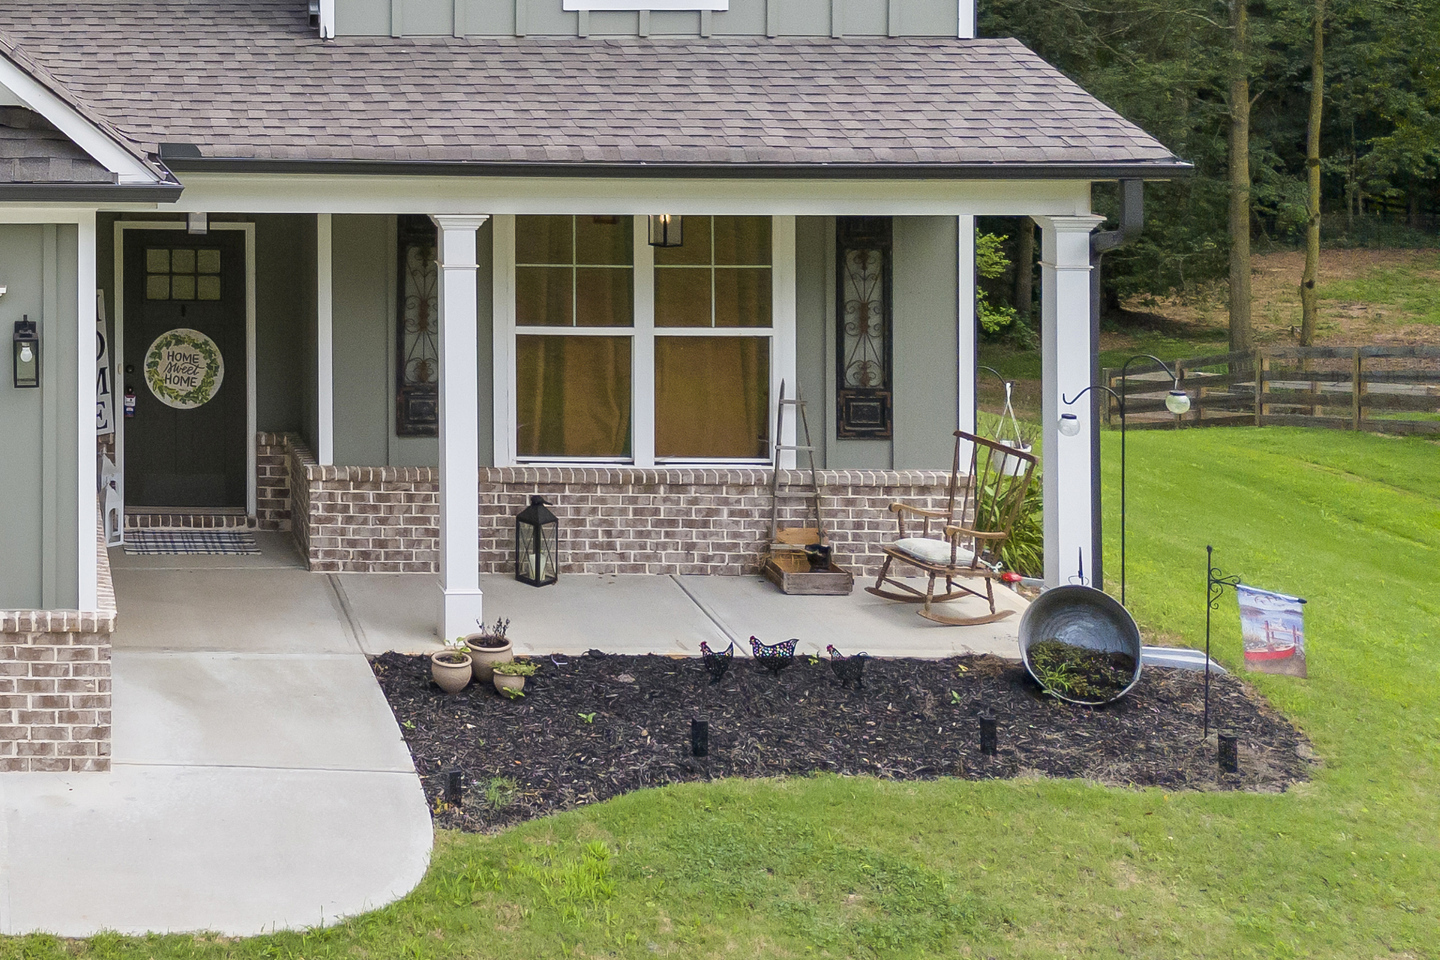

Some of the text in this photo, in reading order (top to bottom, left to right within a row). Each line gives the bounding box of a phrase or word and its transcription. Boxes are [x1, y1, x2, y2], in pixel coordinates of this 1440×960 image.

[167, 350, 200, 364] HOME
[163, 361, 205, 376] sweet
[164, 374, 198, 388] HOME
